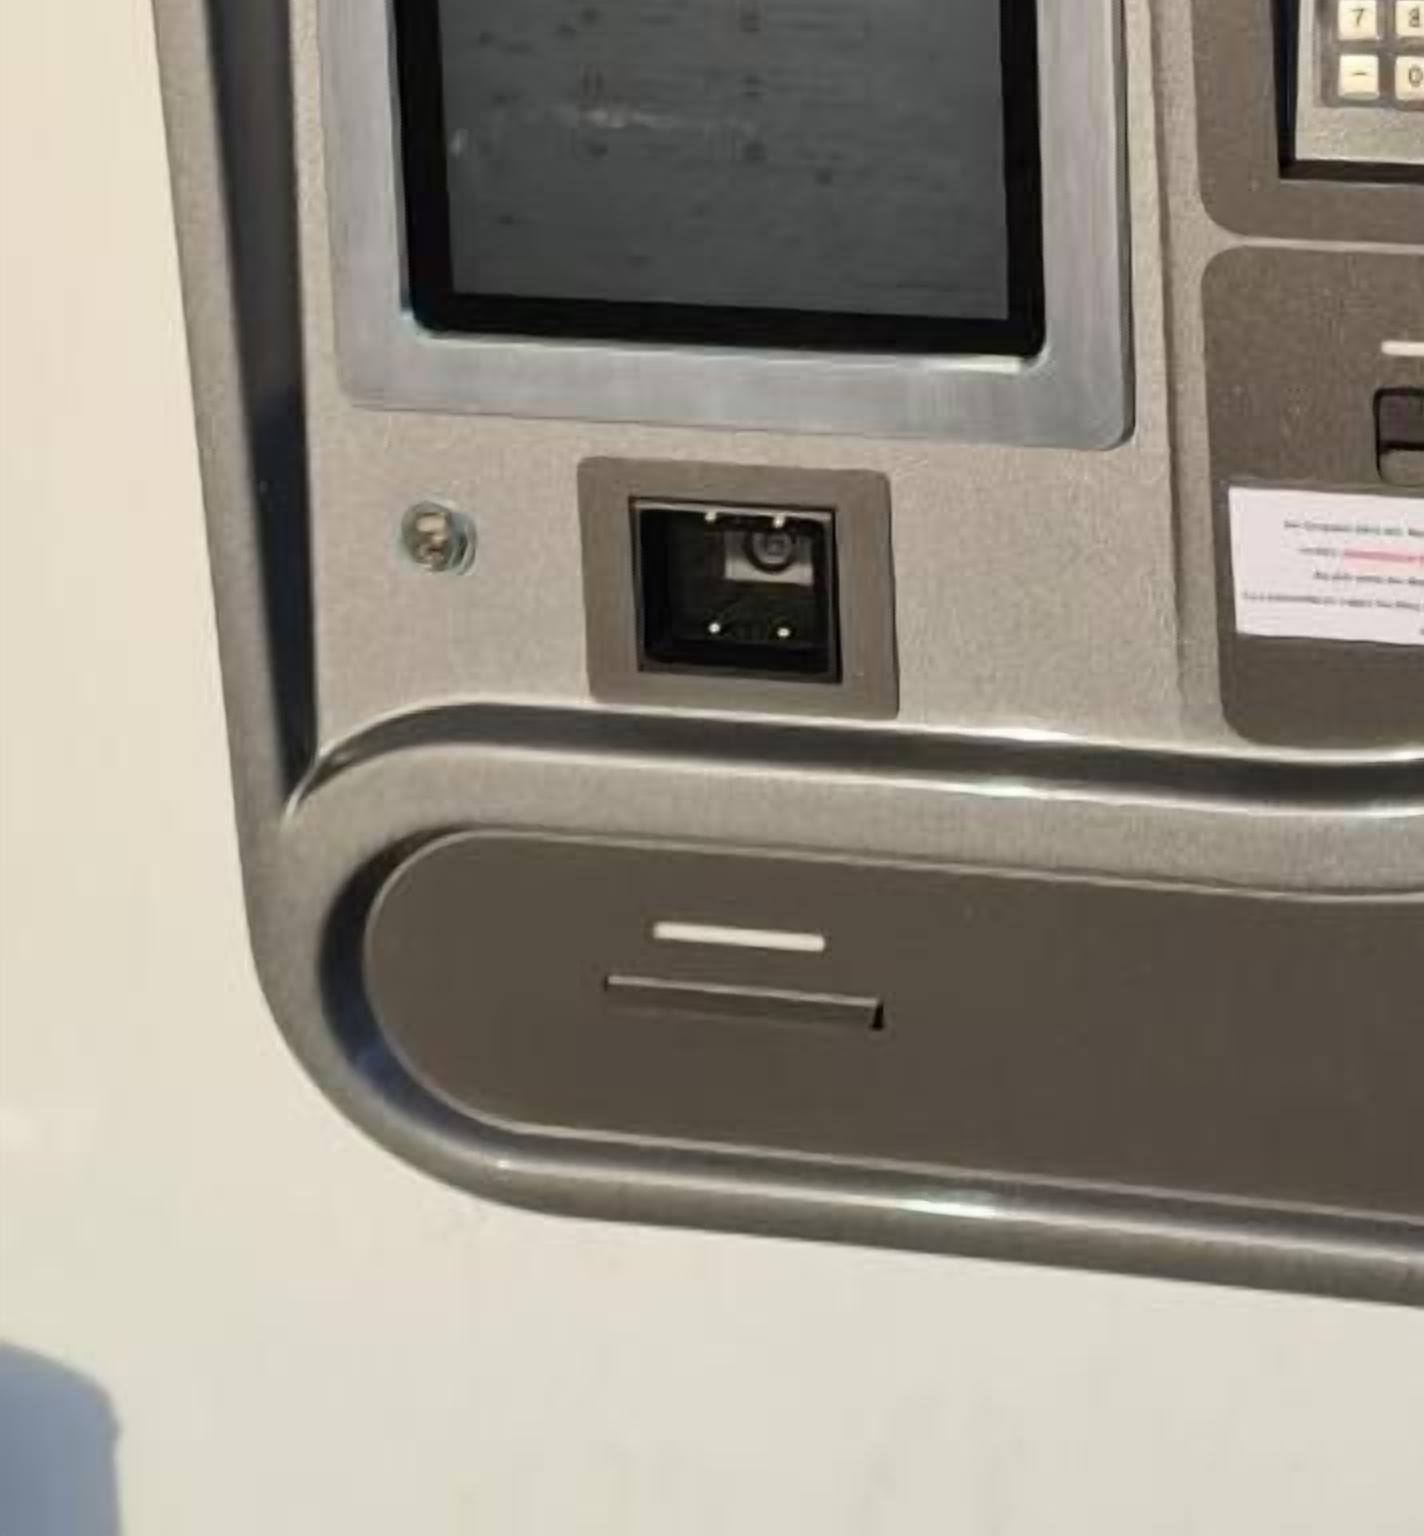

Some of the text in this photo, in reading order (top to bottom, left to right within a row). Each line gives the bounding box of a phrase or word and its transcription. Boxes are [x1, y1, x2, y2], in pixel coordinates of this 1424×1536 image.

[1351, 7, 1366, 28] 7
[1408, 7, 1421, 29] 8
[1407, 66, 1424, 88] 0
